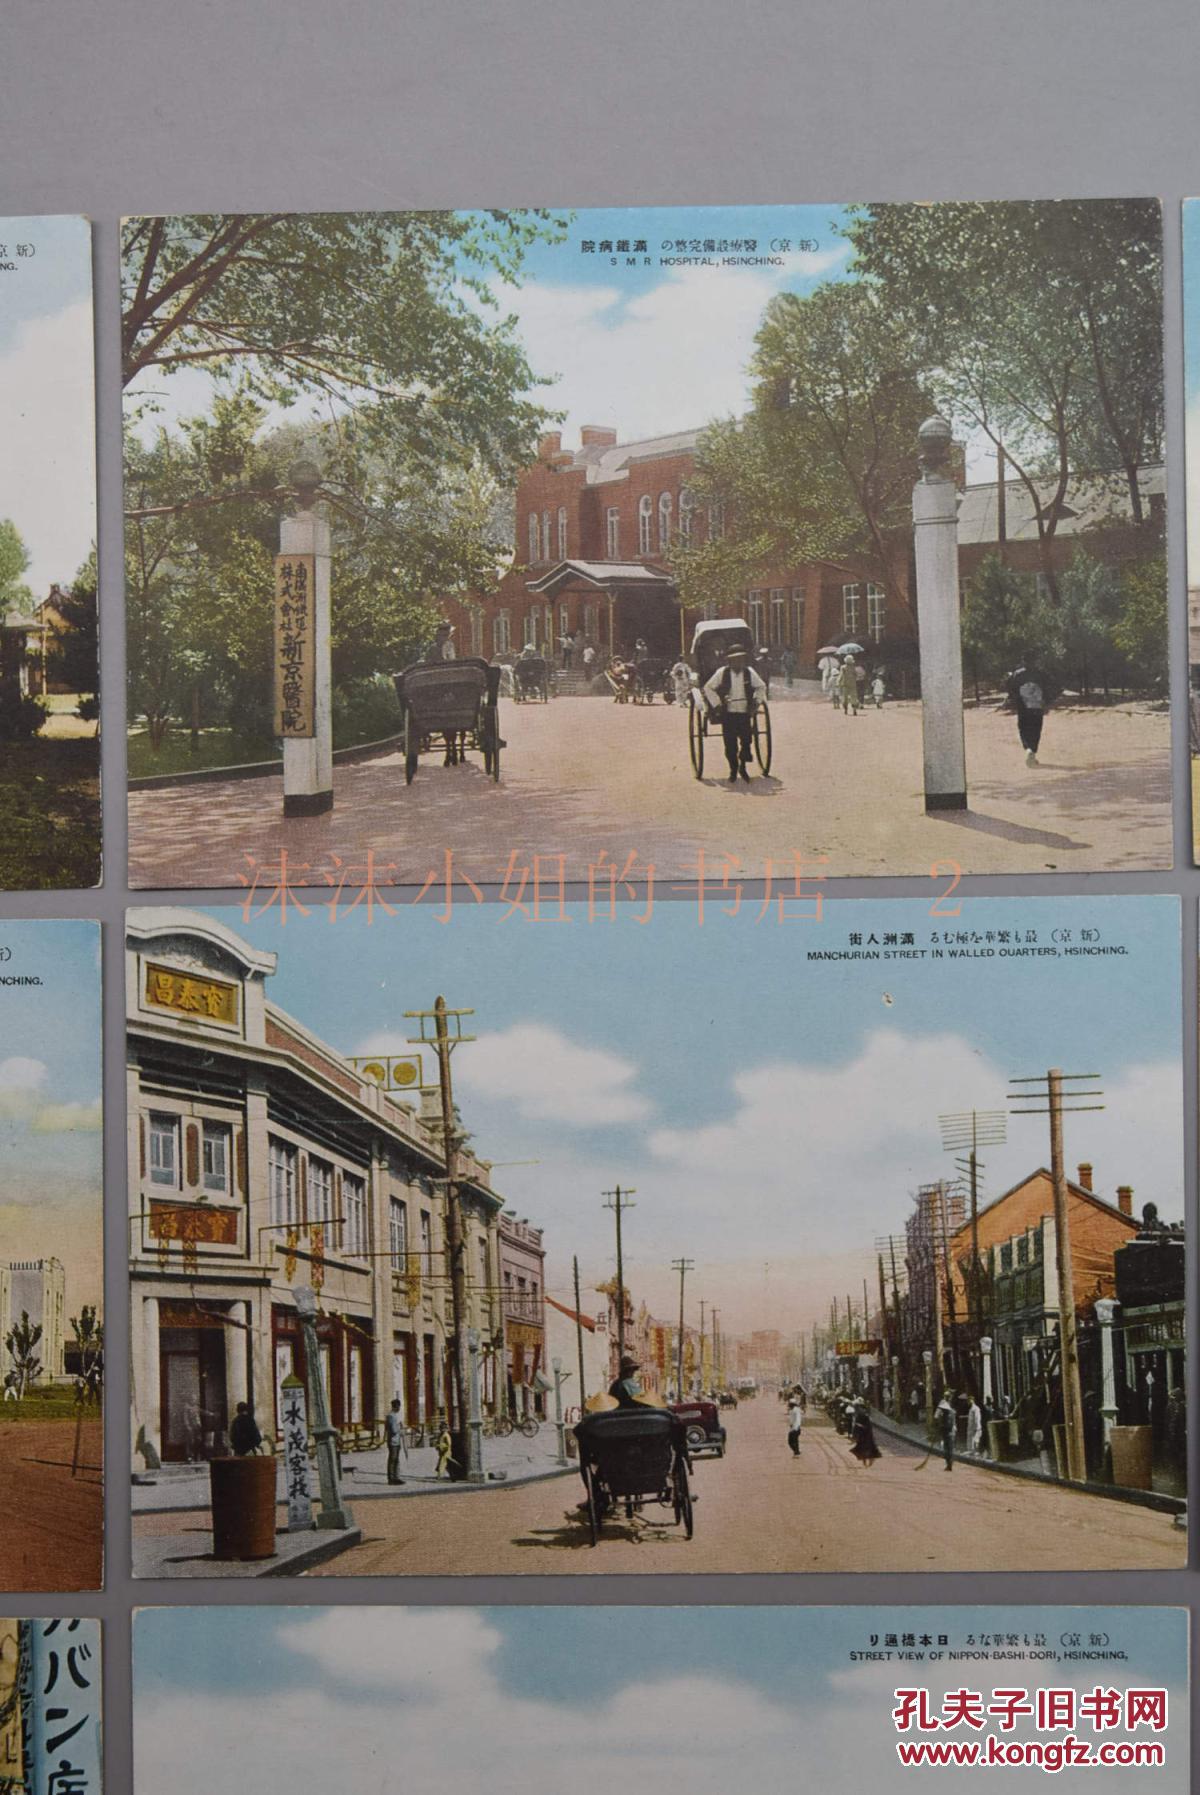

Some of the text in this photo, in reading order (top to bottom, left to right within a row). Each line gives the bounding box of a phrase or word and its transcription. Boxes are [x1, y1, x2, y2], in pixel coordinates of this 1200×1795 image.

[660, 256, 720, 268] HOSPITAL,
[722, 256, 785, 267] HSINCHING.
[807, 949, 880, 961] MANCHURIAN
[883, 948, 927, 960] STREET
[931, 948, 944, 958] IN
[948, 946, 995, 958] WALLED
[1064, 942, 1129, 956] HSINCHING.
[849, 1650, 893, 1662] STREET
[897, 1650, 926, 1662] VIEW
[928, 1650, 945, 1661] OF
